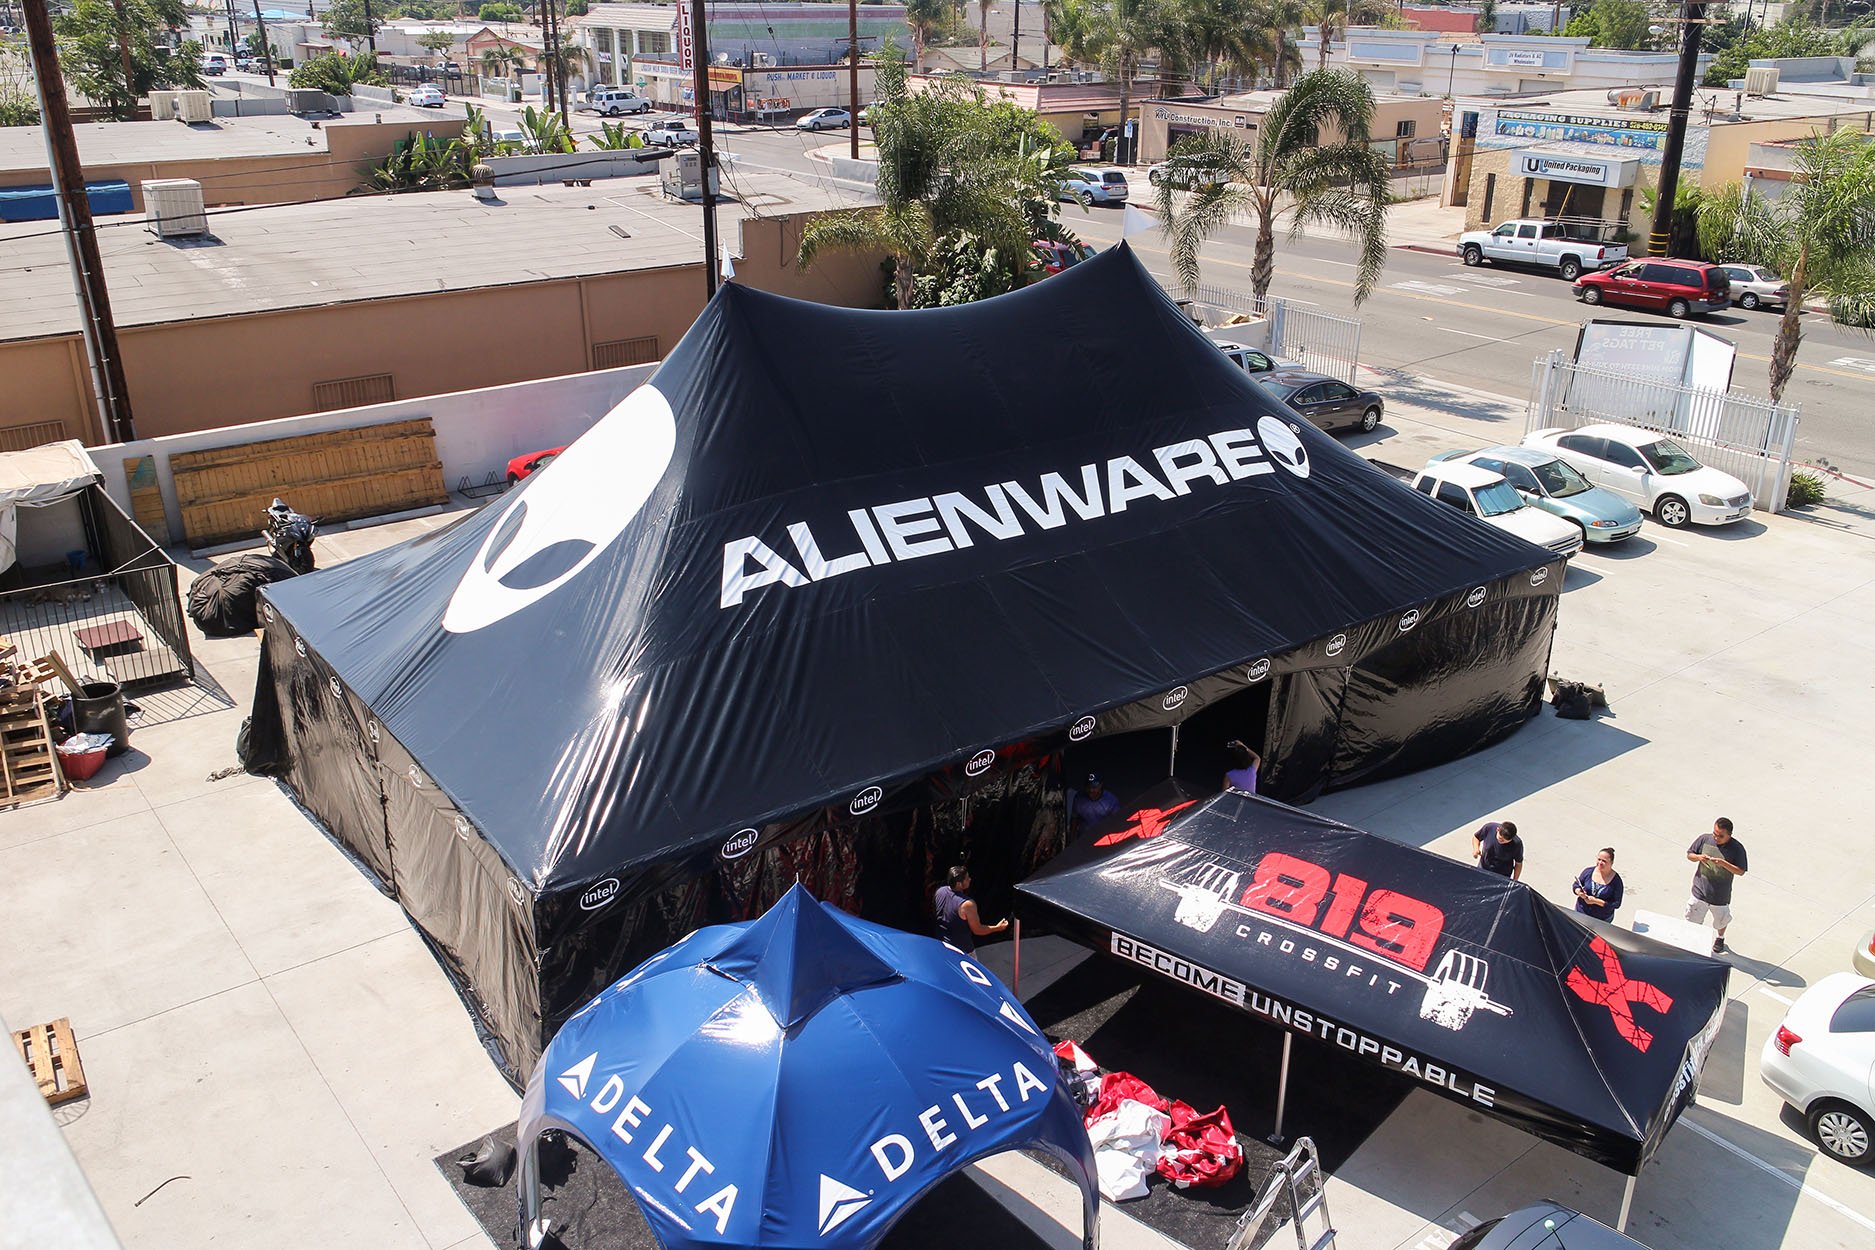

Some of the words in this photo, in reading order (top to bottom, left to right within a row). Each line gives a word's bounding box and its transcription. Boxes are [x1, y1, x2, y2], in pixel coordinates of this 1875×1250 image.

[682, 5, 692, 68] LIQUOR
[787, 72, 809, 80] MARKET
[817, 71, 837, 80] LIQUOR
[1219, 119, 1232, 127] Inc.
[1499, 111, 1567, 123] PACKAGING
[1570, 116, 1629, 128] SUPPLIES
[1543, 160, 1565, 170] United
[1565, 162, 1601, 174] Packaging
[720, 428, 1275, 609] ALIENWARE
[1239, 852, 1445, 972] 819
[1235, 925, 1403, 995] CROSSFIT
[1113, 935, 1244, 1006] BECOME
[1250, 997, 1496, 1108] UNSTOPPABLE
[589, 1073, 739, 1235] DELTA
[870, 1061, 1048, 1182] DELTA
